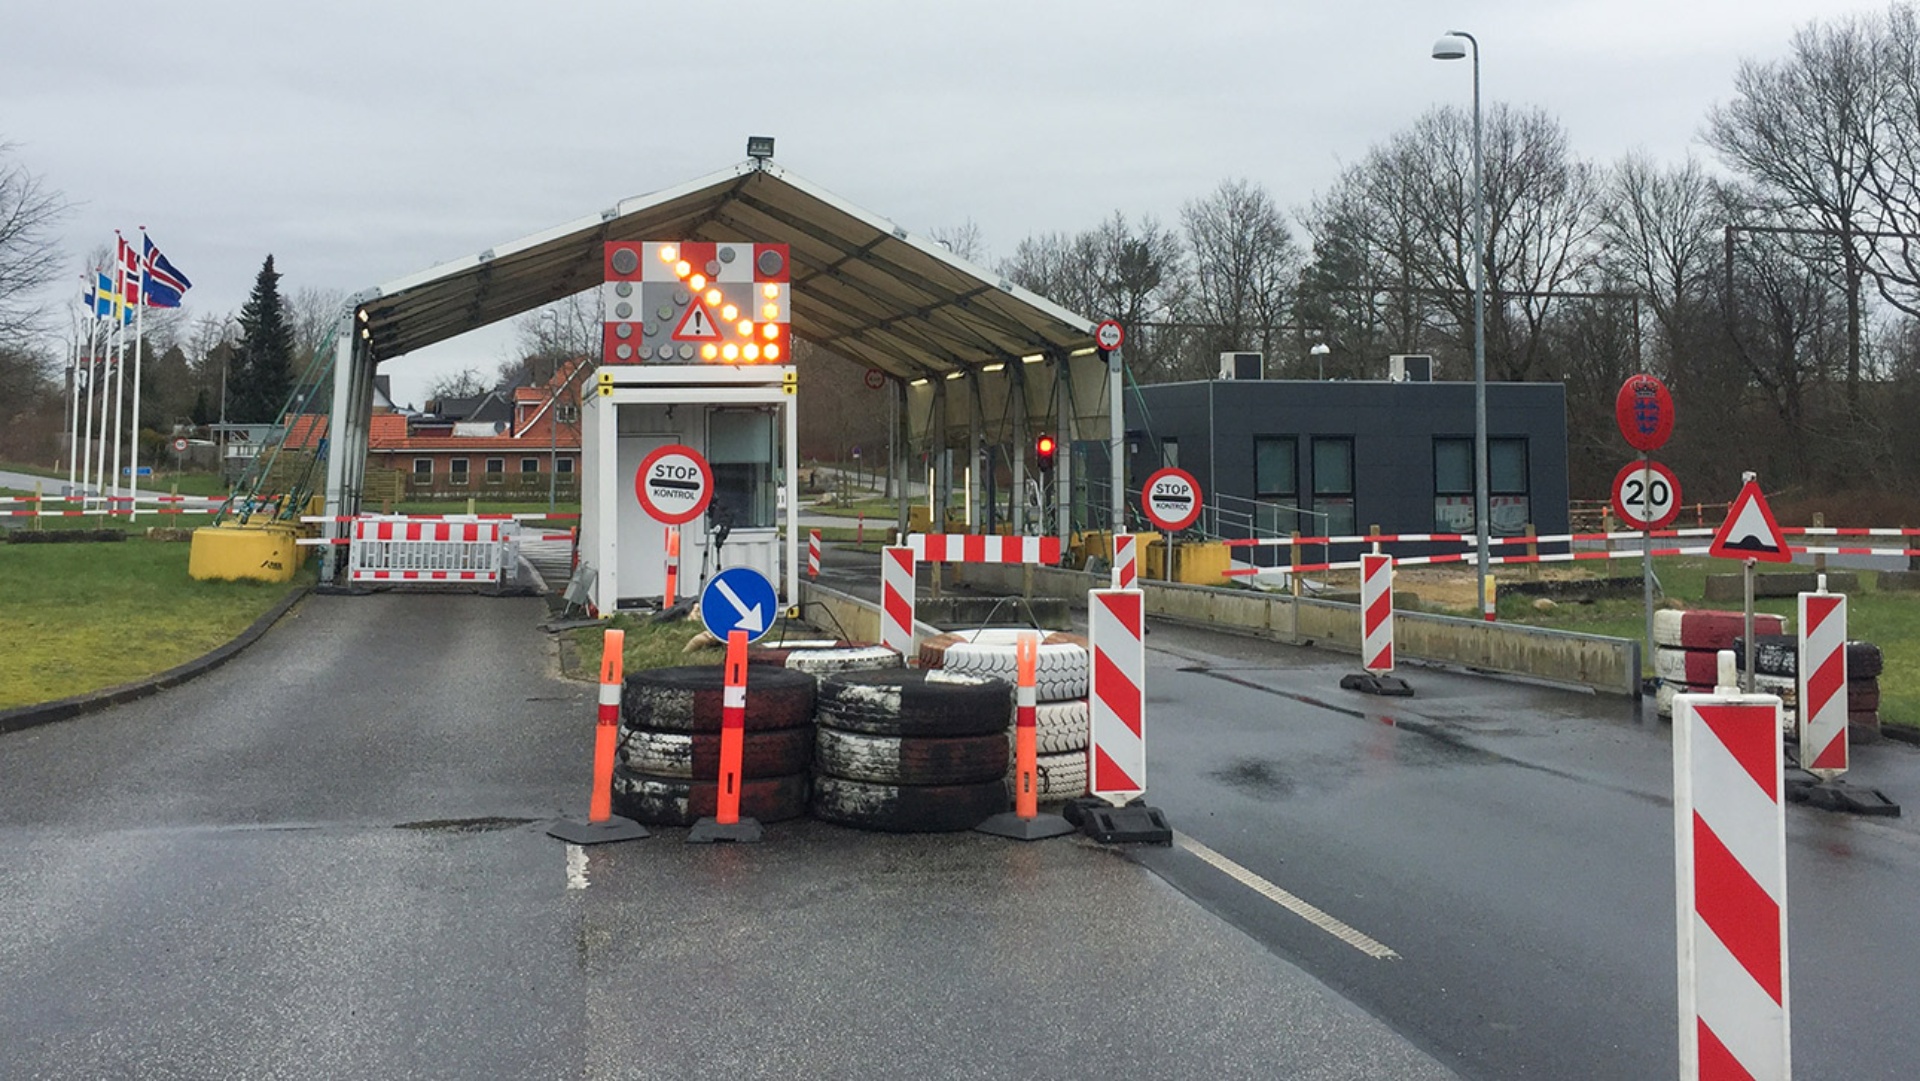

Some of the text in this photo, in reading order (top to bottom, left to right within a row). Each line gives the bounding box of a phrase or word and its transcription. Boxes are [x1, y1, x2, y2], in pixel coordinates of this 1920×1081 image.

[655, 464, 697, 480] STOP
[653, 488, 696, 500] KONTROL
[1156, 484, 1189, 495] STOP
[1626, 479, 1669, 506] 20
[1156, 502, 1189, 511] KONTROL
